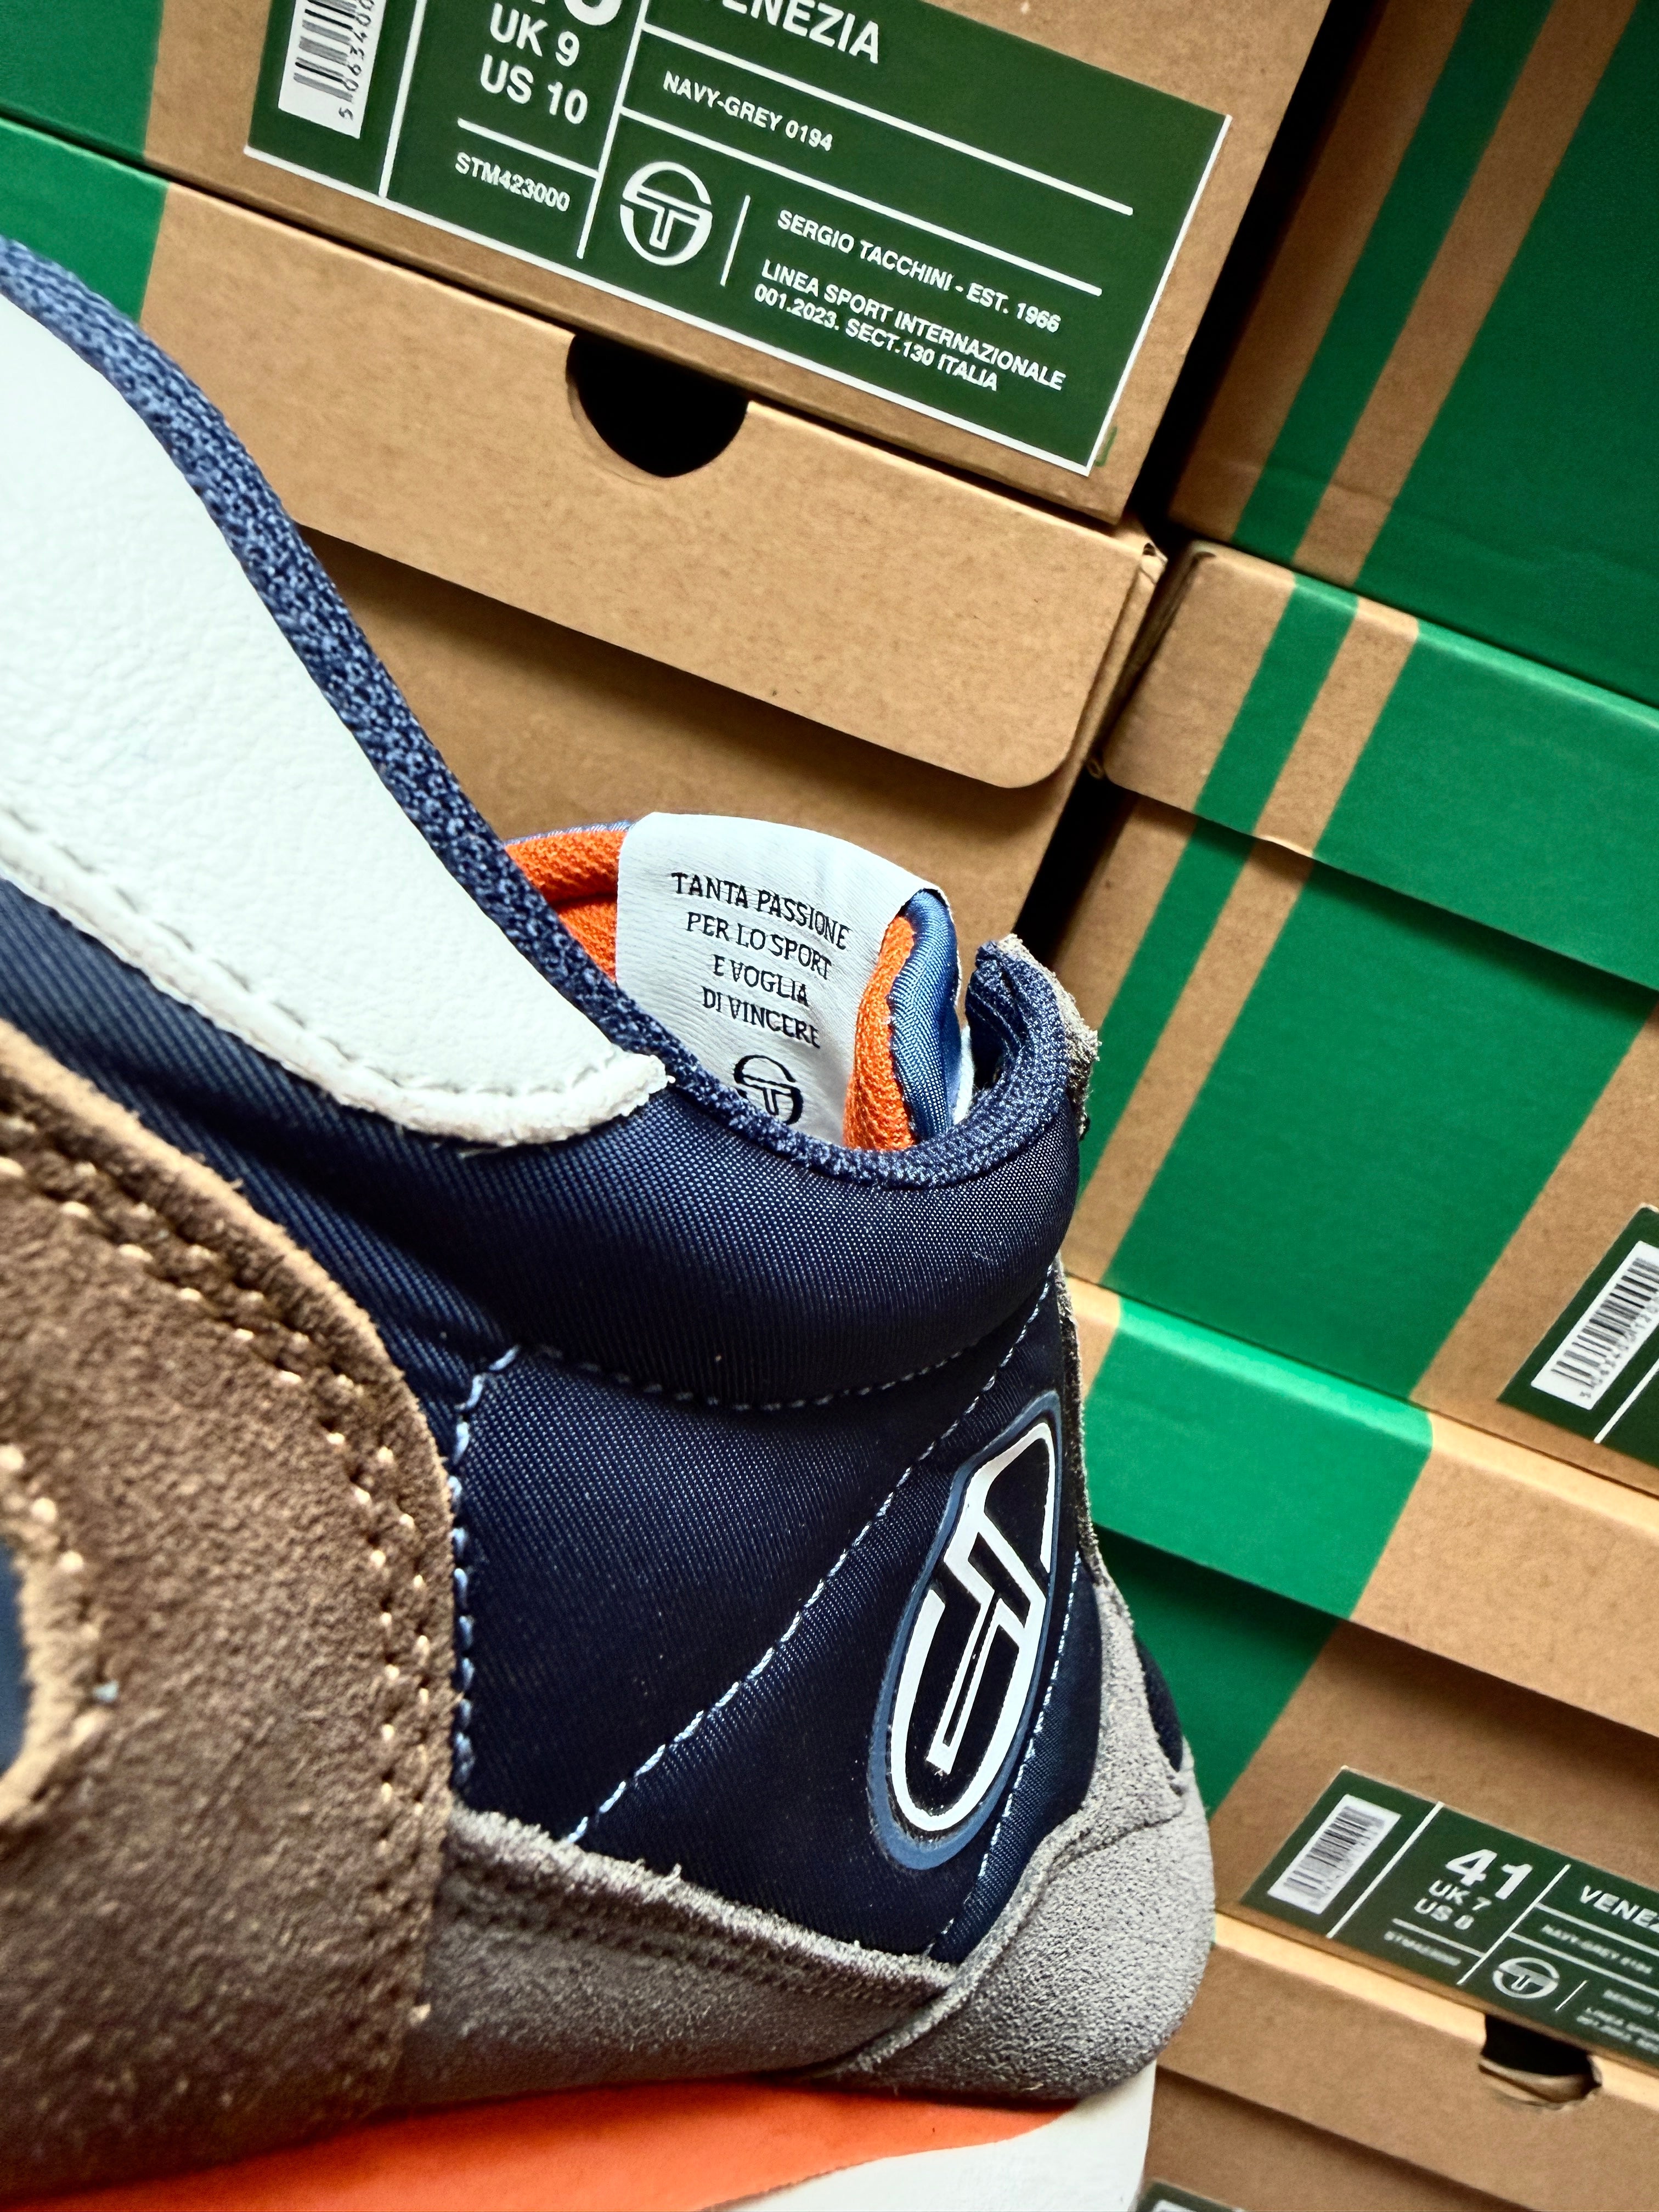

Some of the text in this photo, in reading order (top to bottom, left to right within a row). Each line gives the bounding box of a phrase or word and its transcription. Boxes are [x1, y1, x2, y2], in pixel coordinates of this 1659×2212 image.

[490, 2, 548, 57] UK
[555, 31, 580, 67] 9
[721, 0, 878, 64] NEZIA
[481, 54, 588, 124] US 10
[663, 70, 833, 151] NAVY-GREY 0194
[455, 152, 570, 212] STM423000
[777, 209, 855, 254] SERGIO
[860, 239, 955, 291] TACCHINI
[966, 282, 1009, 314] EST.
[1017, 302, 1061, 333] 1966
[761, 258, 1066, 391] LINEA SPORT INTERNAZIONALE
[937, 353, 997, 392] ITALIA
[671, 872, 850, 950] TANTA PASSIONE
[686, 911, 832, 980] PER LO SPORT
[714, 954, 809, 1007] E VOGLIA
[701, 986, 820, 1049] DI VINCERE
[1429, 1879, 1492, 1911] UK 7
[1445, 1848, 1534, 1900] 41
[1414, 1897, 1453, 1921] US
